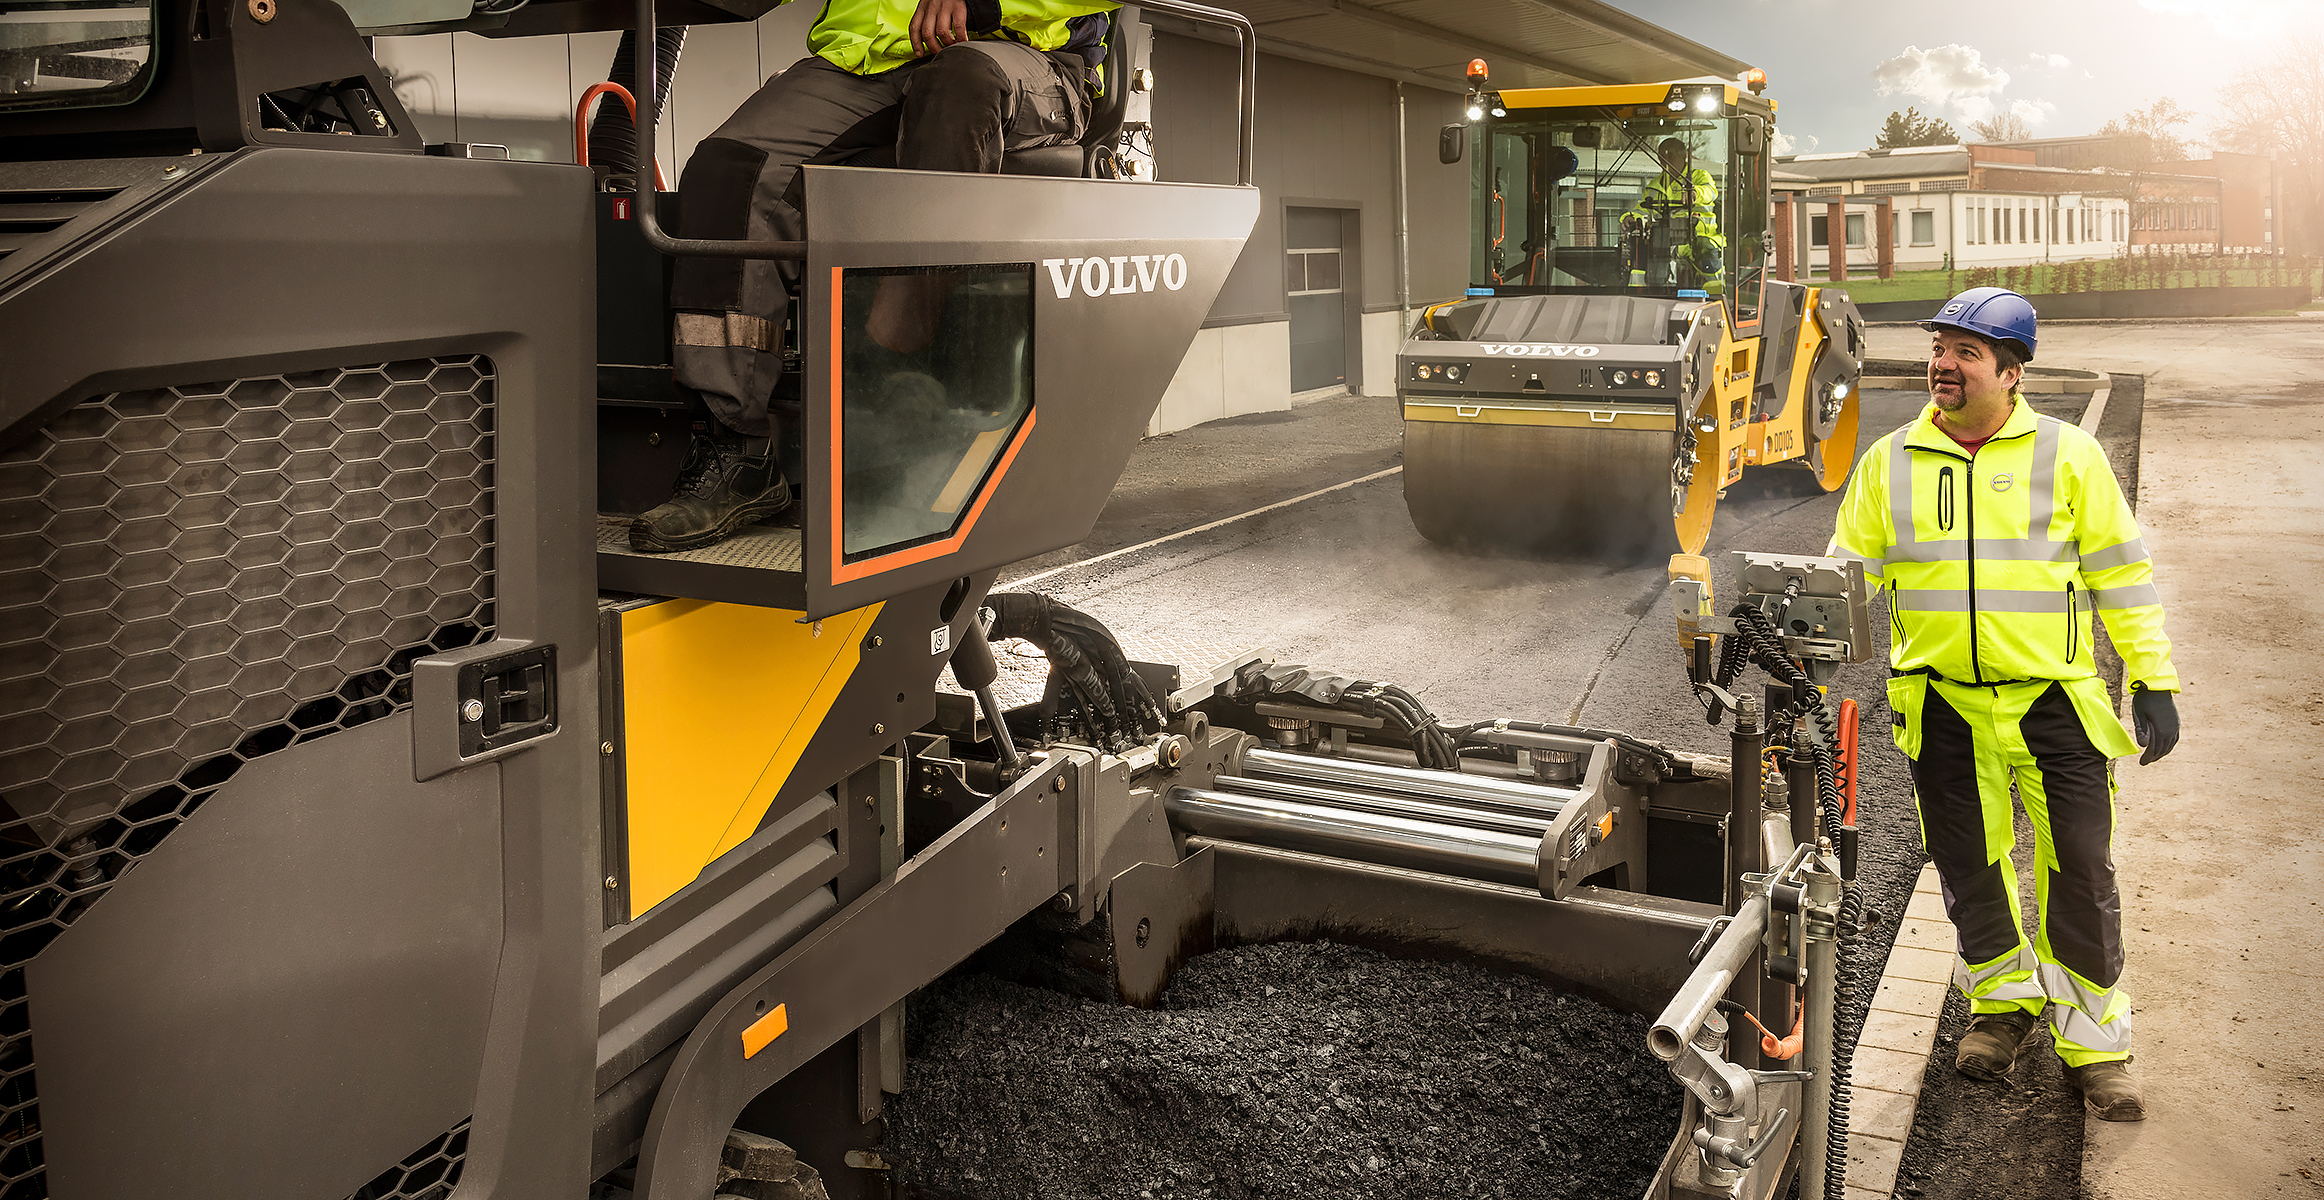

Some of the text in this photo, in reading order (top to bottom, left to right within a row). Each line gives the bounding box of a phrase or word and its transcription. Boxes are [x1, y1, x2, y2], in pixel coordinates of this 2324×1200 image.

[1042, 253, 1188, 299] VOLVO
[1480, 344, 1600, 357] VOLVO
[1774, 429, 1793, 453] DD105
